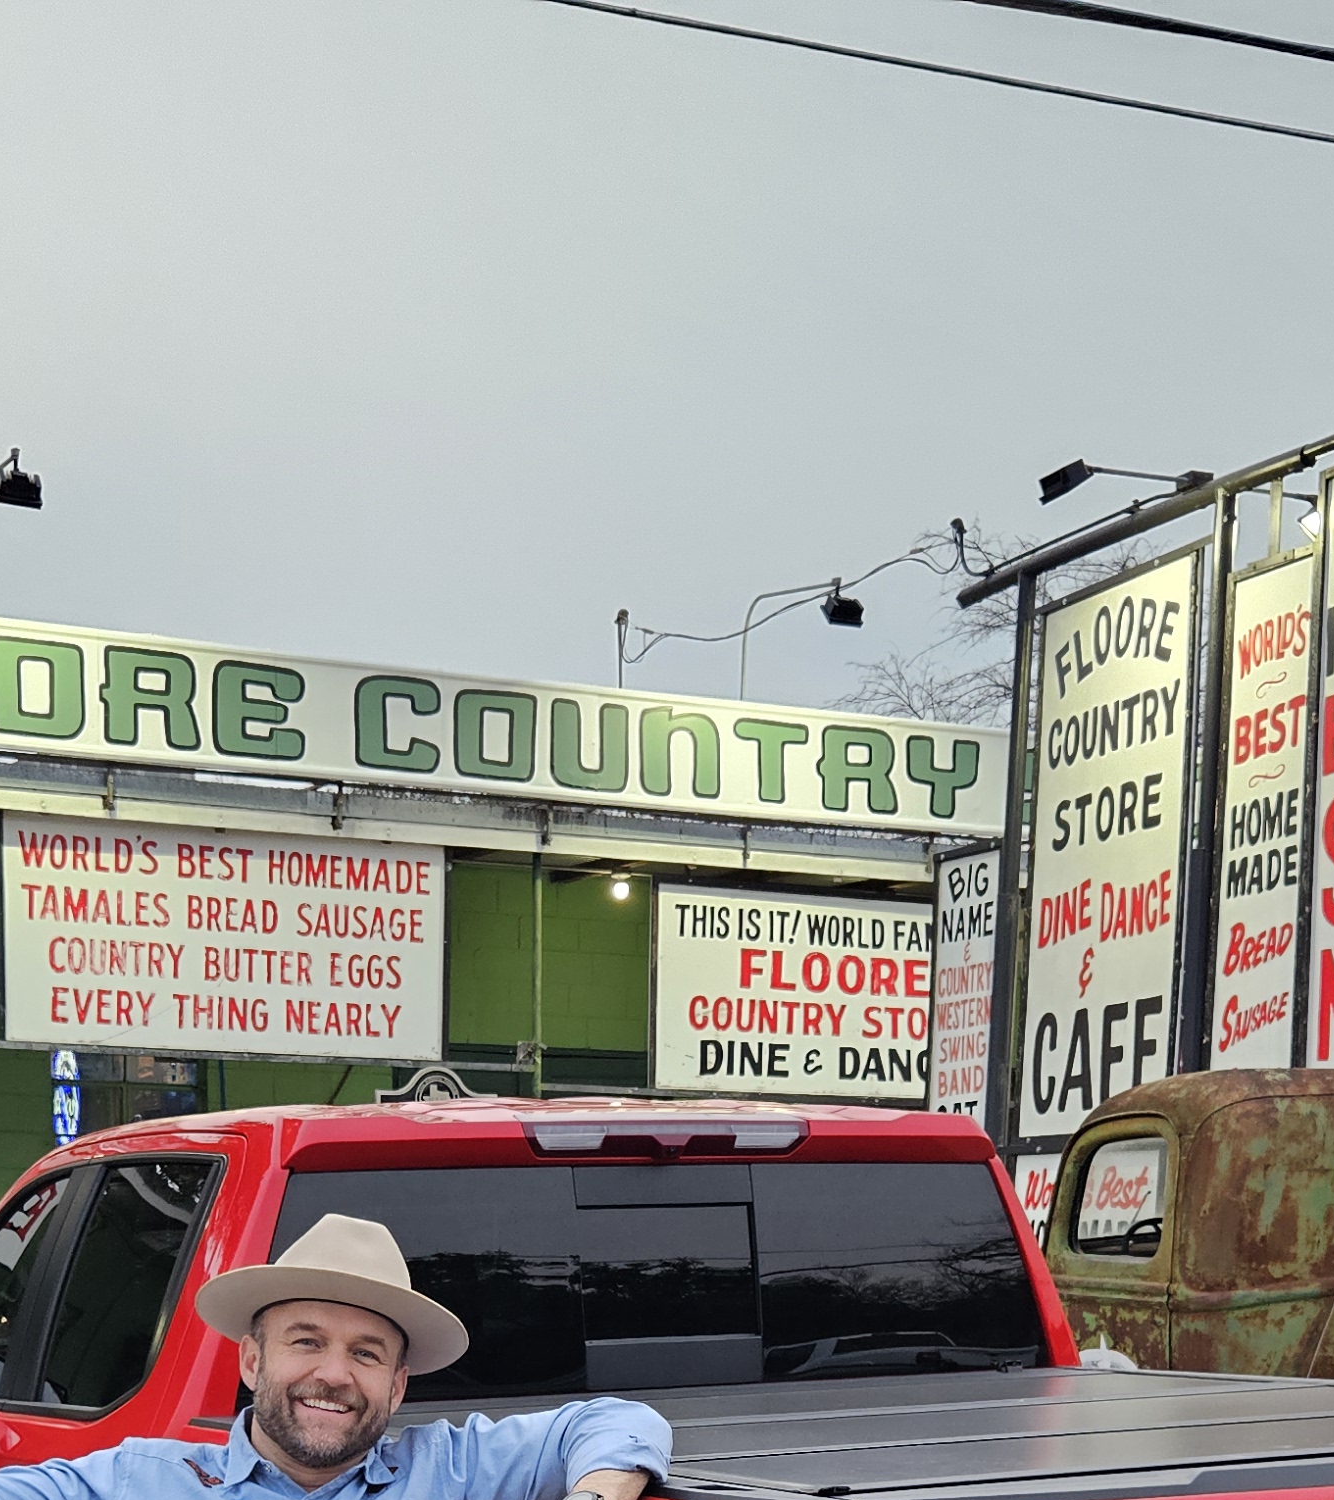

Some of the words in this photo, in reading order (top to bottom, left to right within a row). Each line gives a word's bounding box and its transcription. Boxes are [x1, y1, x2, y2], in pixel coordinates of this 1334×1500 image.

[1054, 597, 1181, 700] FLOORE
[1237, 603, 1313, 680] WORLD'S
[353, 674, 980, 818] COUNTRY
[1048, 678, 1181, 771] COUNTRY
[1233, 693, 1309, 767] BEST
[1051, 772, 1164, 852] STORE
[1229, 787, 1300, 852] HOME
[17, 830, 159, 875] WORLD'S
[176, 842, 255, 884] BEST
[267, 850, 432, 897] HOMEMADE
[947, 862, 989, 904] BIG
[1226, 845, 1299, 899] MADE
[19, 883, 171, 929] TAMALES
[186, 893, 280, 937] BREAD
[295, 902, 424, 944] SAUSAGE
[674, 902, 731, 941] THIS
[737, 907, 763, 941] IS
[766, 911, 804, 943] IT!
[805, 913, 888, 951] WORLD
[940, 901, 995, 944] NAME
[1037, 879, 1093, 951] DINE
[1099, 869, 1172, 944] DANCE
[47, 935, 186, 978] COUNTRY
[202, 944, 314, 987] BUTTER
[329, 952, 403, 990] EGGS
[739, 948, 930, 998] FLOORE
[937, 960, 994, 999] COUNTRY
[1078, 946, 1095, 999] &
[50, 988, 156, 1028] EVERY
[172, 994, 269, 1033] THING
[284, 1000, 402, 1040] NEARLY
[688, 995, 847, 1038] COUNTRY
[936, 995, 992, 1032] WESTERN
[698, 1040, 790, 1079] DINE
[803, 1046, 823, 1075] &
[938, 1031, 988, 1065] SWING
[1032, 994, 1164, 1116] CAFE
[937, 1064, 985, 1099] BAND
